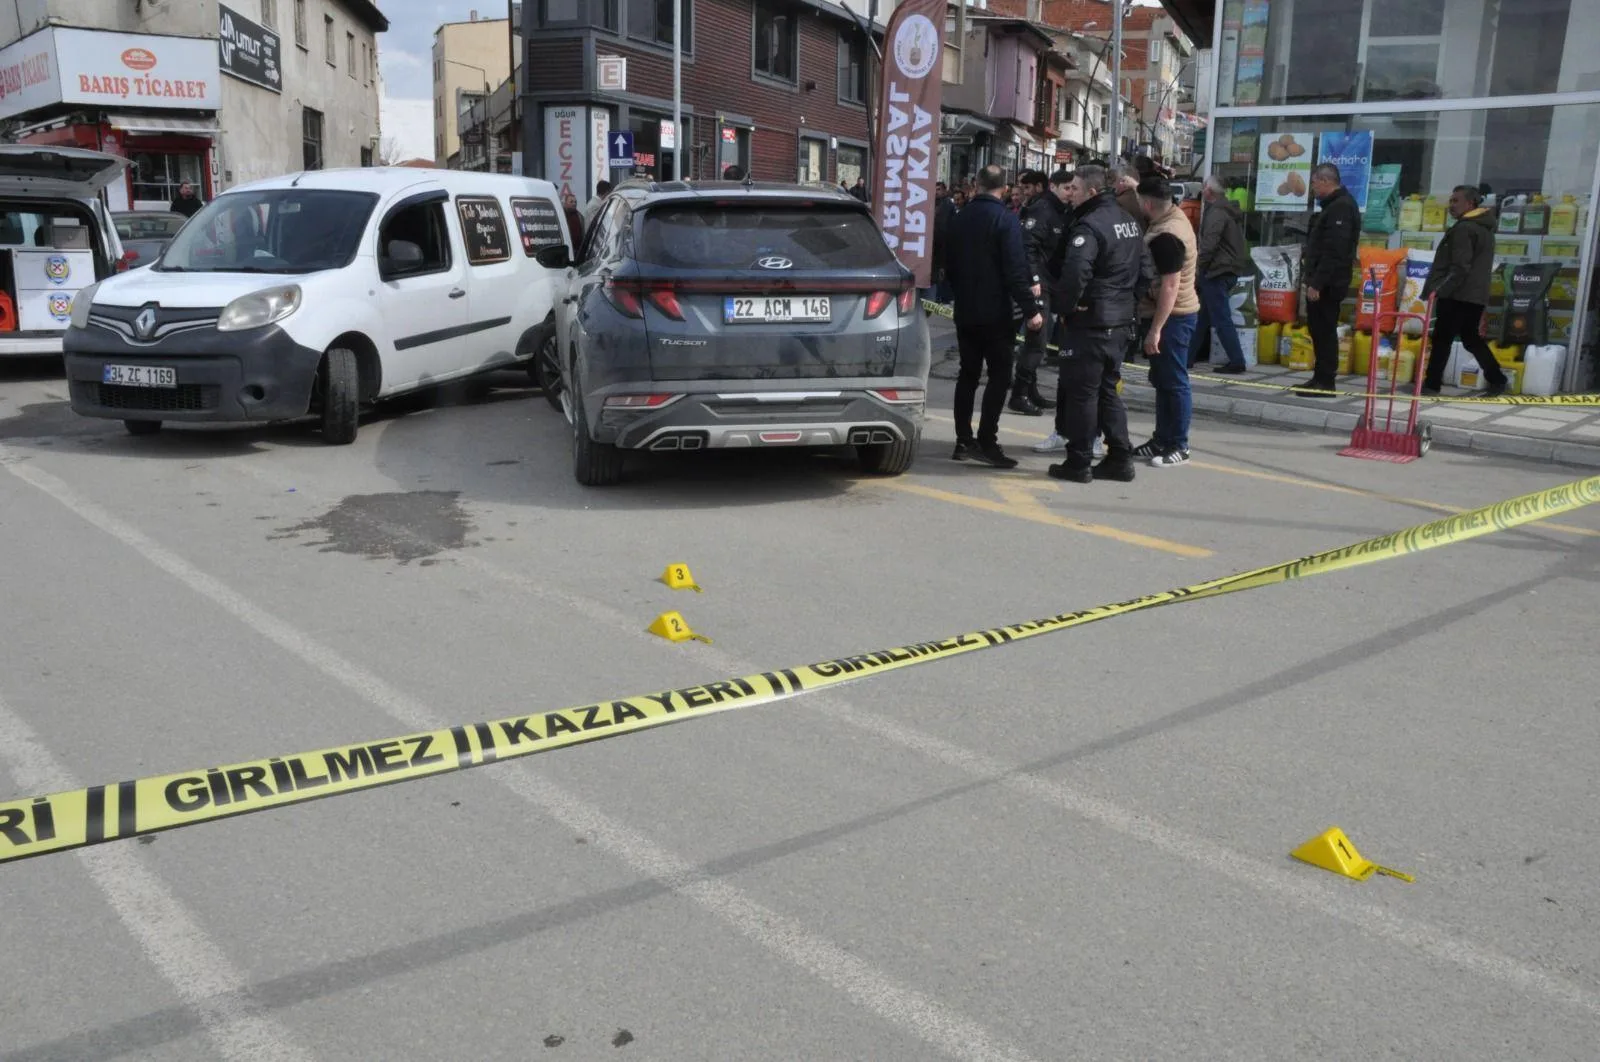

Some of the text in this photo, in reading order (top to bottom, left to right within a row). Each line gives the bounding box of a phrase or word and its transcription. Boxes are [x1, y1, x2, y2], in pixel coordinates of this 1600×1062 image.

[604, 65, 617, 84] E
[79, 72, 206, 99] BARIŞ TİCARET
[554, 110, 576, 119] UĞUR
[558, 120, 573, 199] ECZA
[634, 152, 655, 167] ZANE
[735, 299, 829, 317] 22 ACM 146
[111, 367, 173, 384] 34 ZC 1169
[676, 568, 684, 580] 3
[671, 618, 682, 632] 2
[498, 701, 647, 747] KAZA
[164, 734, 445, 813] GİRİLMEZ
[0, 796, 56, 847] Rİ
[1337, 839, 1352, 860] 1
